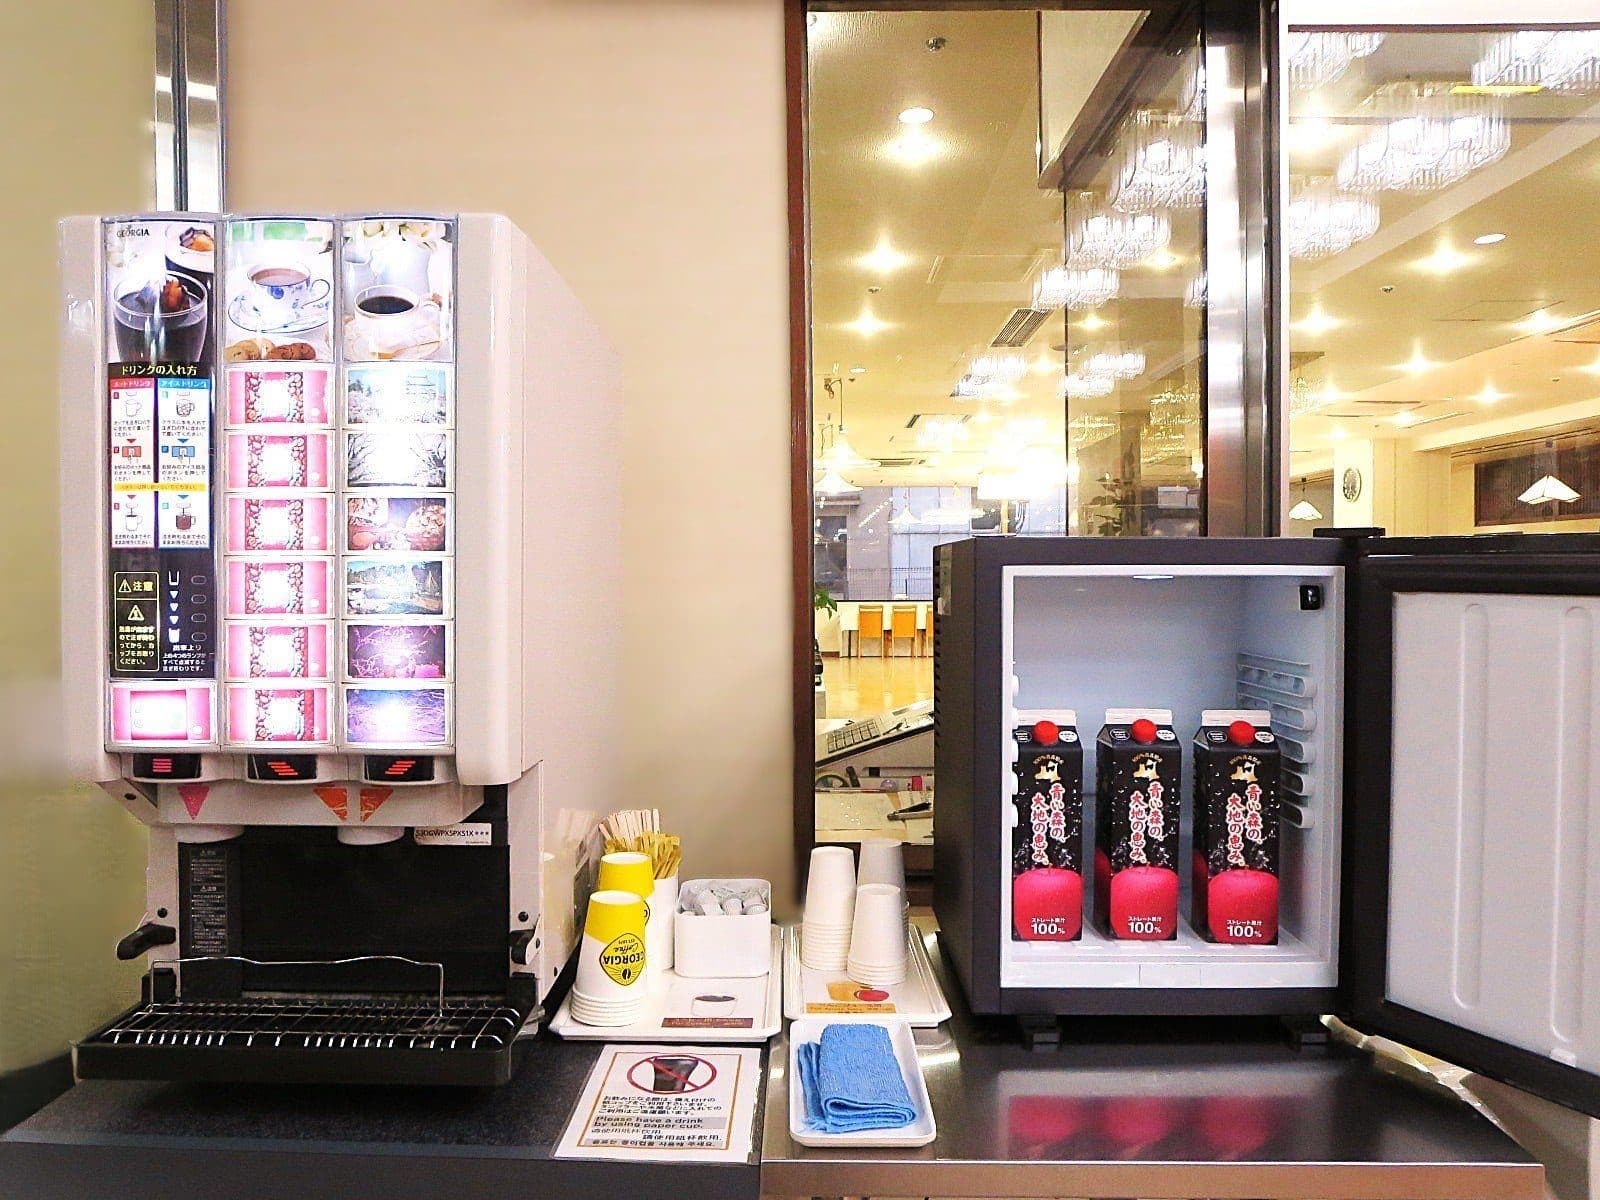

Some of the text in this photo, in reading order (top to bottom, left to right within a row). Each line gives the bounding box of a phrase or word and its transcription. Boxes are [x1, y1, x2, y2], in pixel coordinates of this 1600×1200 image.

[116, 226, 150, 238] GEORGIA
[122, 365, 197, 376] ドリンクの入れ方
[1031, 792, 1049, 864] 大地の恵み
[1050, 782, 1065, 842] 青い森の
[1129, 791, 1147, 864] 大地の恵み
[1148, 781, 1164, 842] 青い森の
[1227, 793, 1245, 866] 大地の恵み
[1246, 784, 1262, 842] 青い森の
[1031, 923, 1065, 935] 100%
[1128, 922, 1162, 934] 100%
[1226, 925, 1262, 938] 100%
